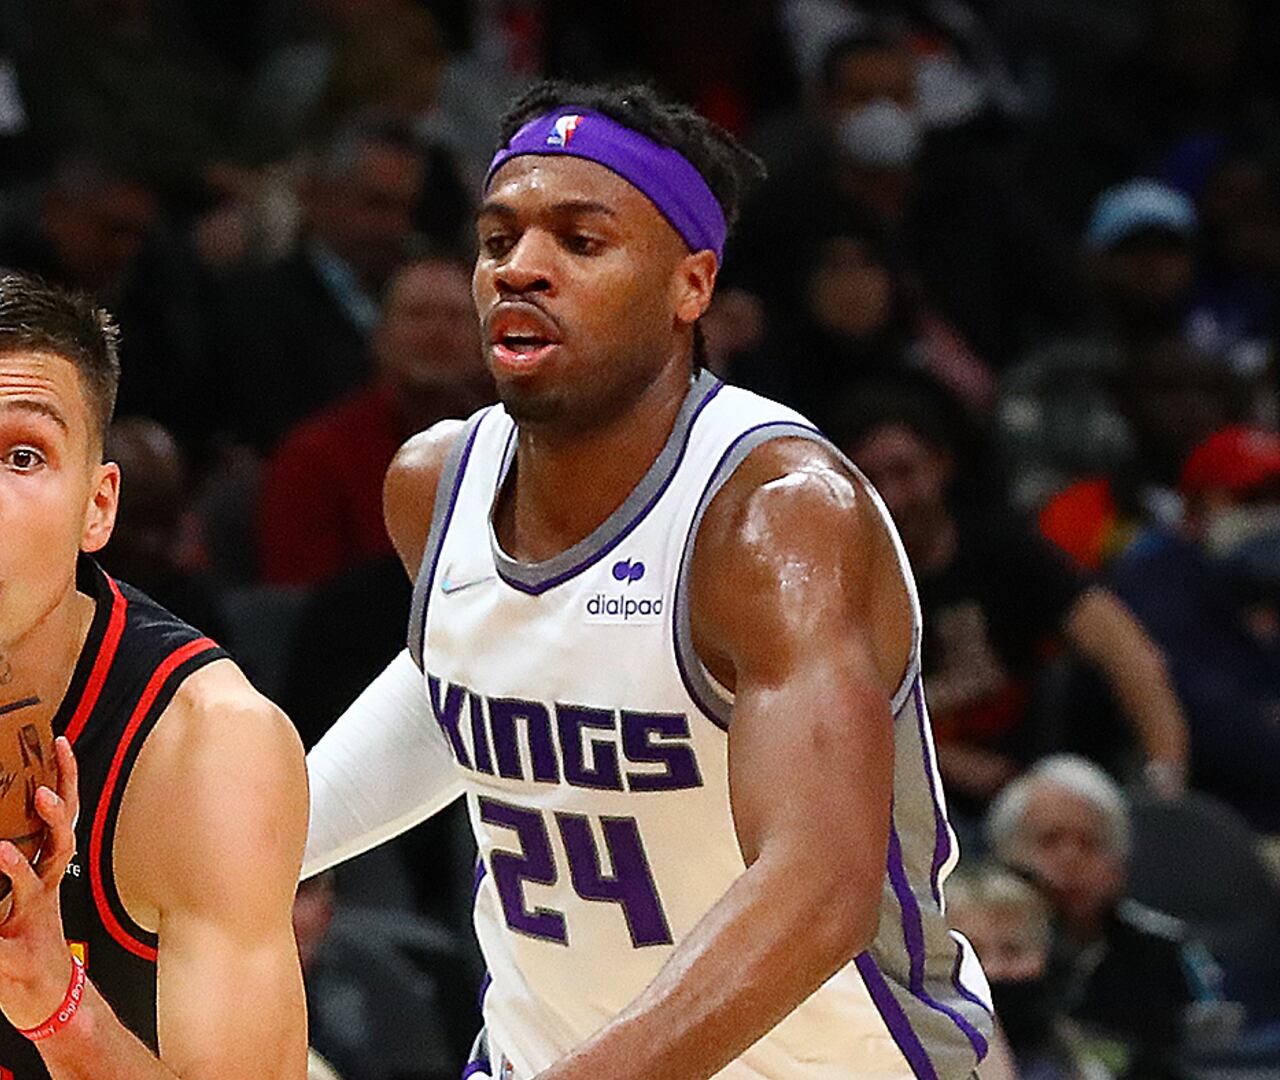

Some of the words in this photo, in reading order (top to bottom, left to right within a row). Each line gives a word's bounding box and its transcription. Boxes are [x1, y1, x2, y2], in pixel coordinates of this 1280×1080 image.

[587, 594, 664, 620] dialpad
[427, 672, 704, 793] KINGS
[477, 794, 674, 949] 24
